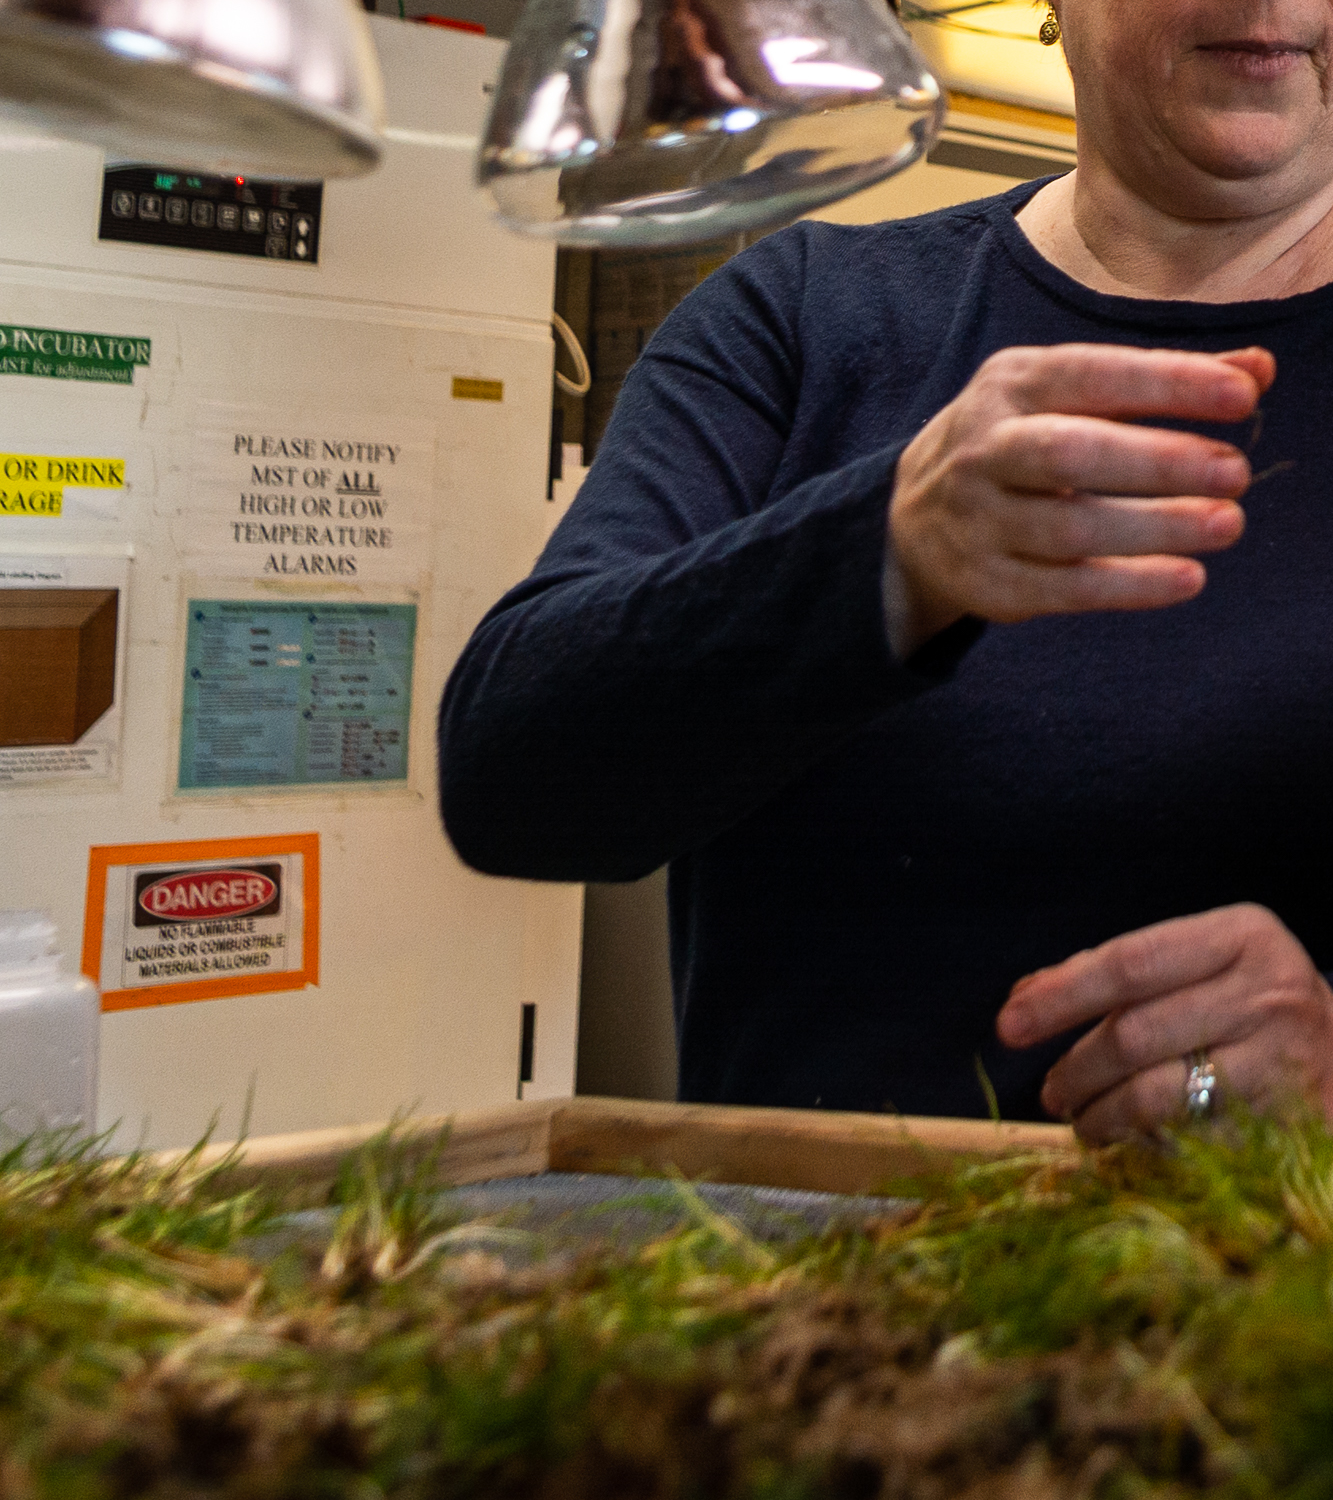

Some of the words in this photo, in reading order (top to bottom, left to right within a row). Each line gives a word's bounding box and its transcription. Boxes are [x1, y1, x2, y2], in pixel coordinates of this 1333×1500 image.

[13, 329, 150, 363] INCUBATOR
[234, 433, 316, 460] PLEASE
[322, 439, 400, 465] NOTIFY
[4, 457, 38, 482] OR
[47, 459, 124, 486] DRINK
[251, 464, 299, 487] MST
[303, 466, 333, 488] OF
[337, 470, 381, 493] ALL
[240, 492, 296, 516] HIGH
[301, 495, 333, 518] OR
[339, 497, 389, 520] LOW
[230, 521, 393, 548] TEMPERATURE
[263, 552, 358, 576] ALARMS
[151, 877, 266, 912] DANGER
[158, 924, 180, 941] NO
[181, 918, 256, 939] FLAMMABLE
[125, 943, 176, 962] LIQUIDS
[179, 940, 198, 956] OR
[199, 933, 286, 956] COMBUSTIBLE
[138, 959, 209, 978] MATERIALS
[211, 951, 271, 971] ALLOWED
